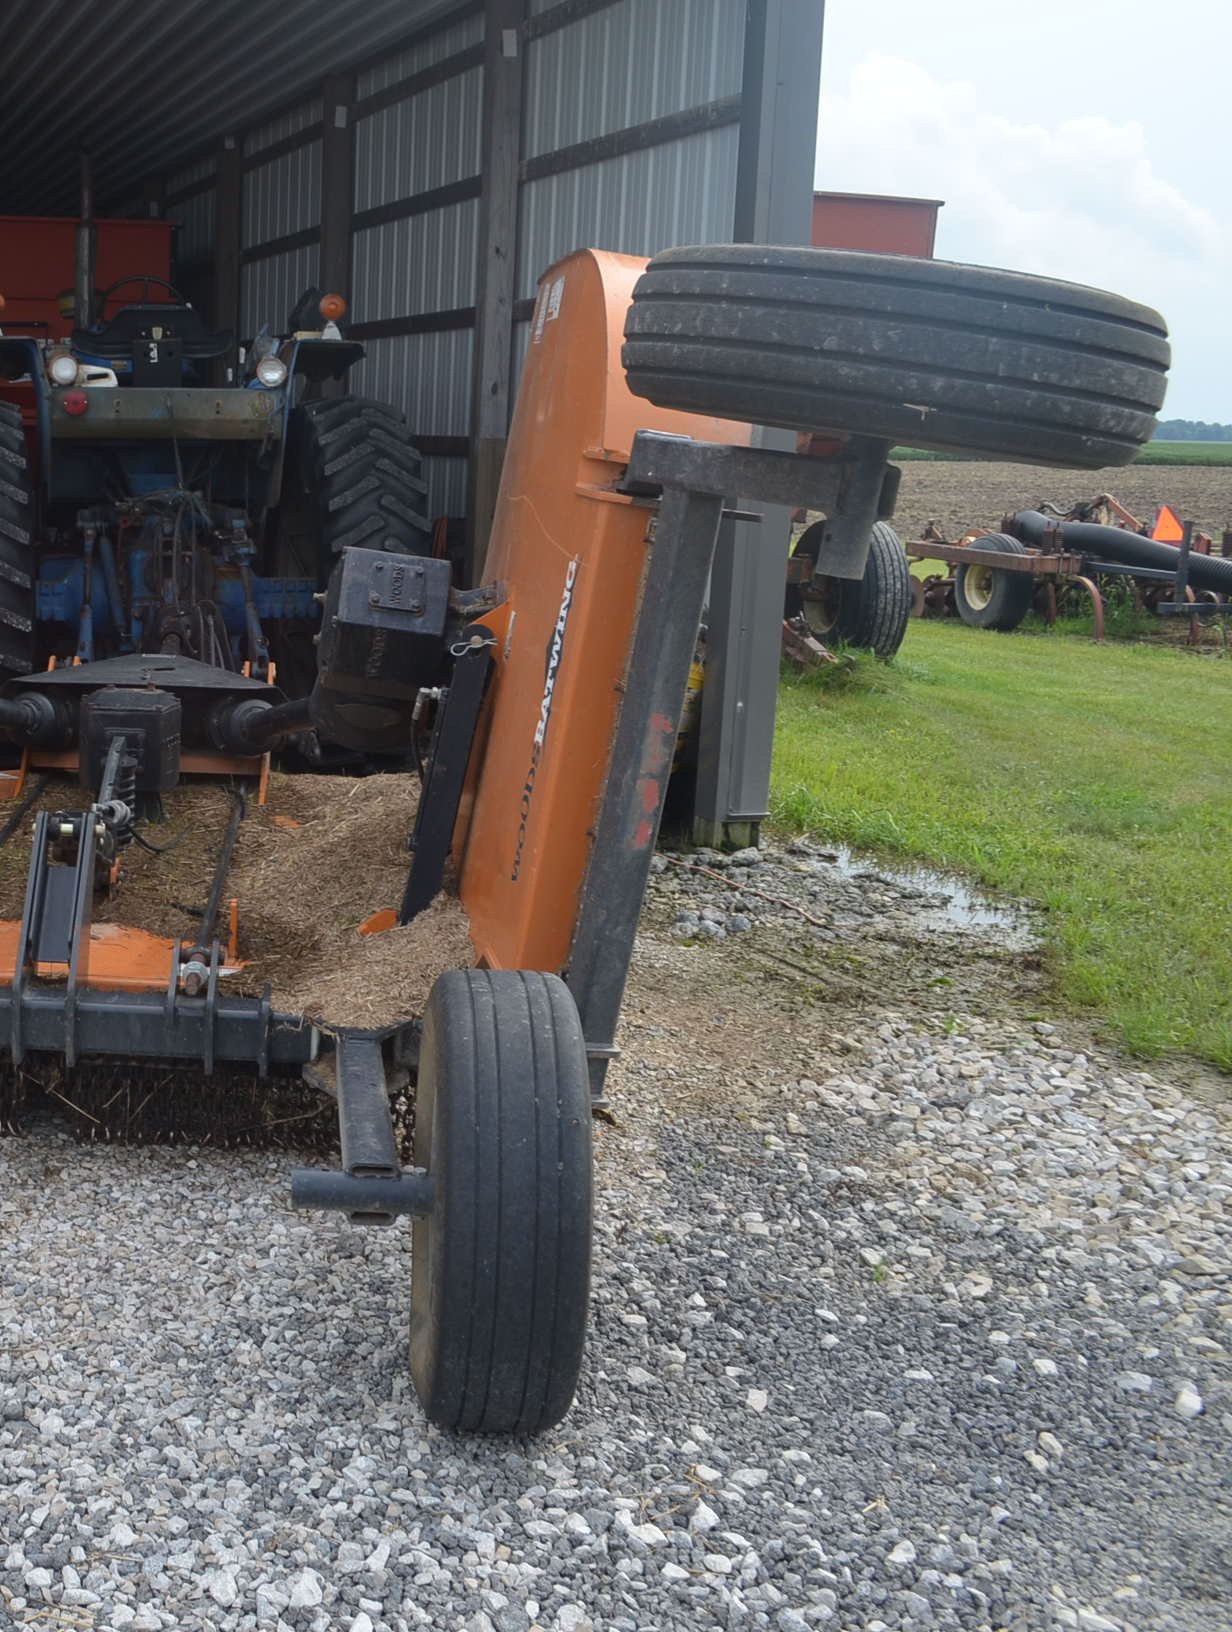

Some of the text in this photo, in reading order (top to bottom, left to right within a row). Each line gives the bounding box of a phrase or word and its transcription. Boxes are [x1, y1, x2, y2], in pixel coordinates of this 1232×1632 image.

[390, 564, 406, 607] WOODS
[510, 558, 578, 882] WOODS BATWING
